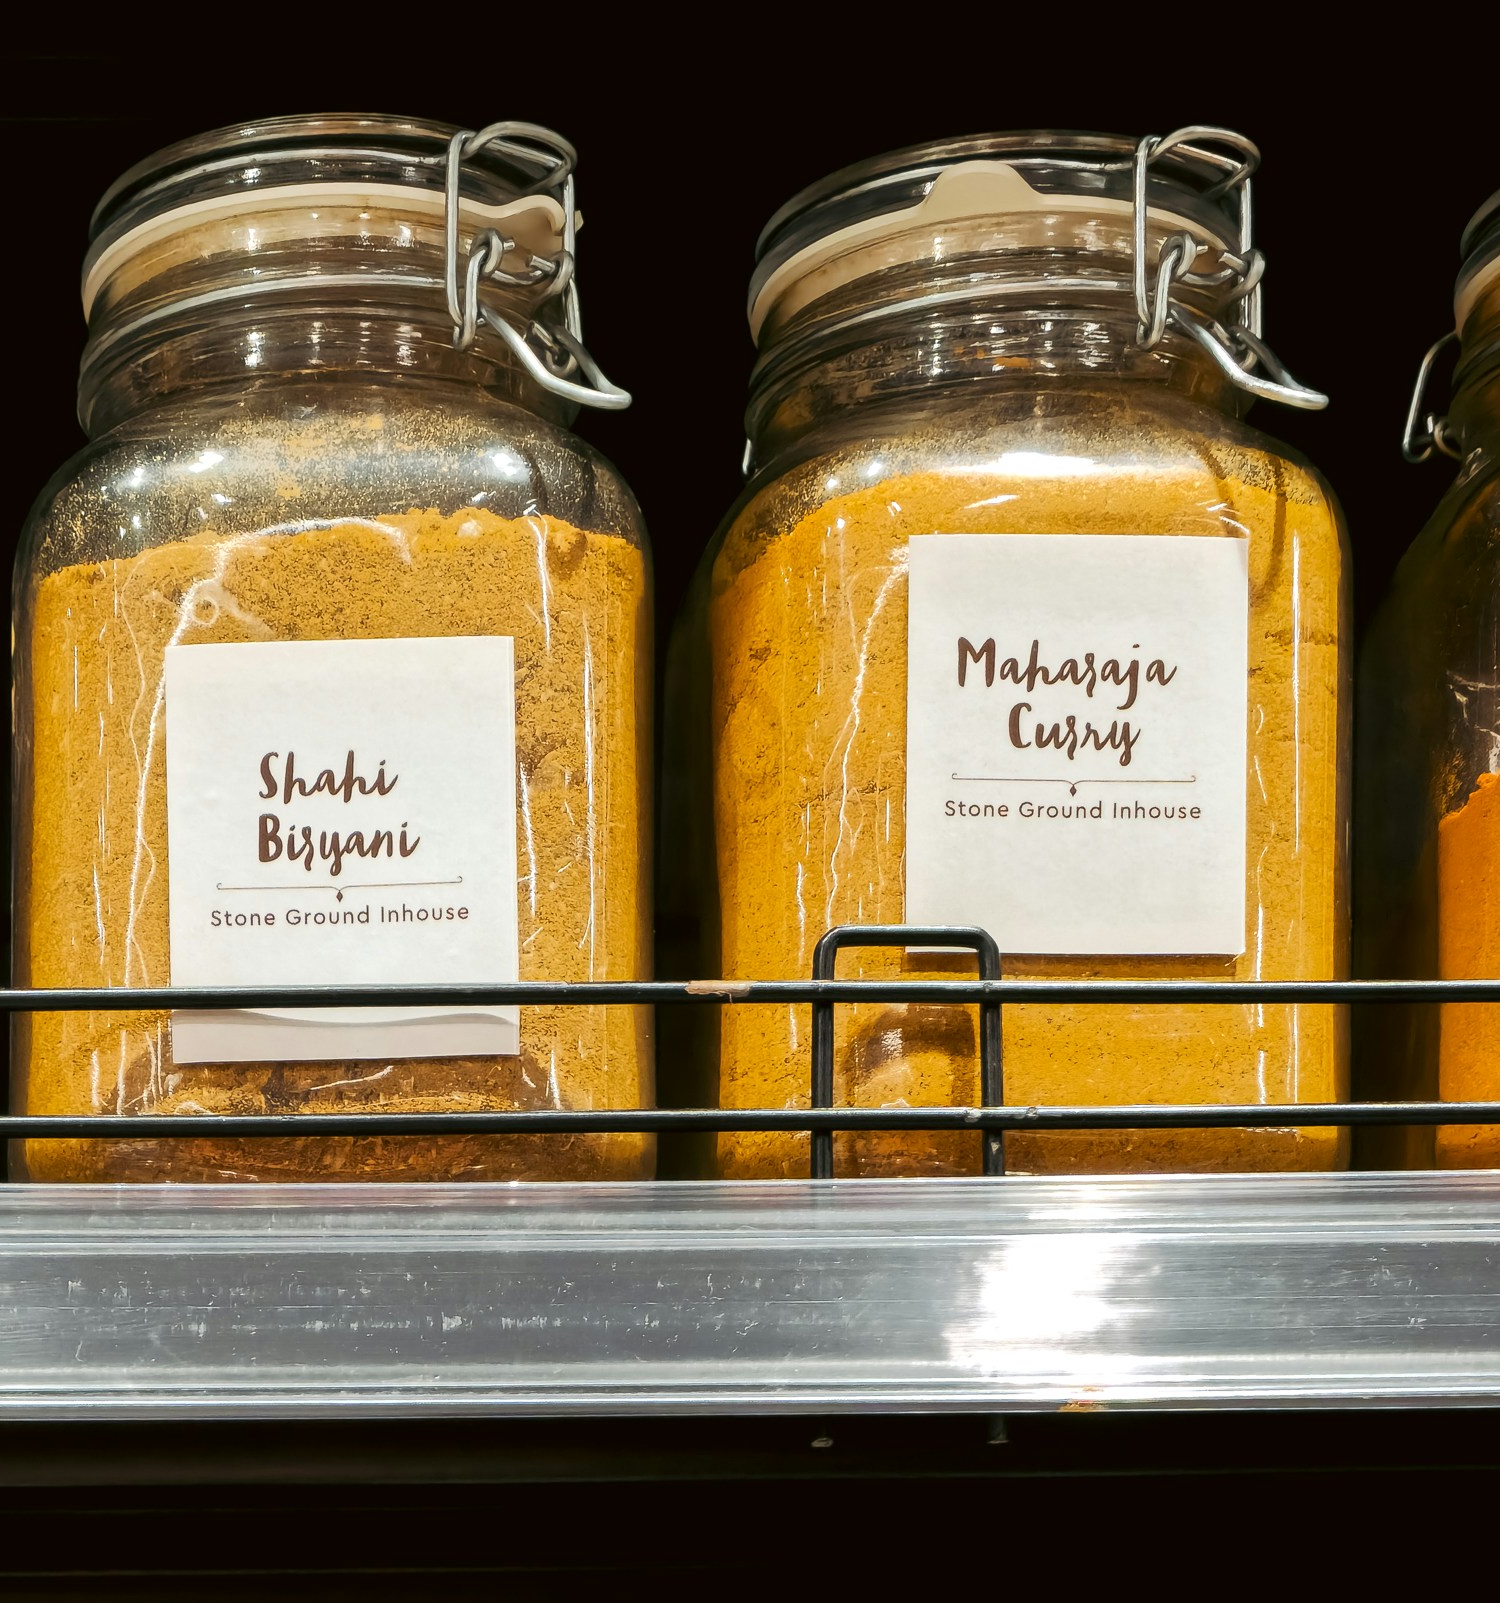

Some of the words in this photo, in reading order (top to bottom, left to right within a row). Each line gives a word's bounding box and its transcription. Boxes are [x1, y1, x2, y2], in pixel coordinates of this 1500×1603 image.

[958, 637, 1177, 712] Maharaja
[1008, 702, 1141, 766] Curry
[259, 749, 398, 804] Shahi
[945, 800, 1009, 817] Stone
[1019, 800, 1102, 819] Ground
[1113, 800, 1201, 820] Inhouse
[258, 813, 420, 876] Biryani
[210, 910, 276, 928] Stone
[286, 904, 370, 926] Ground
[381, 903, 470, 924] Inhouse
